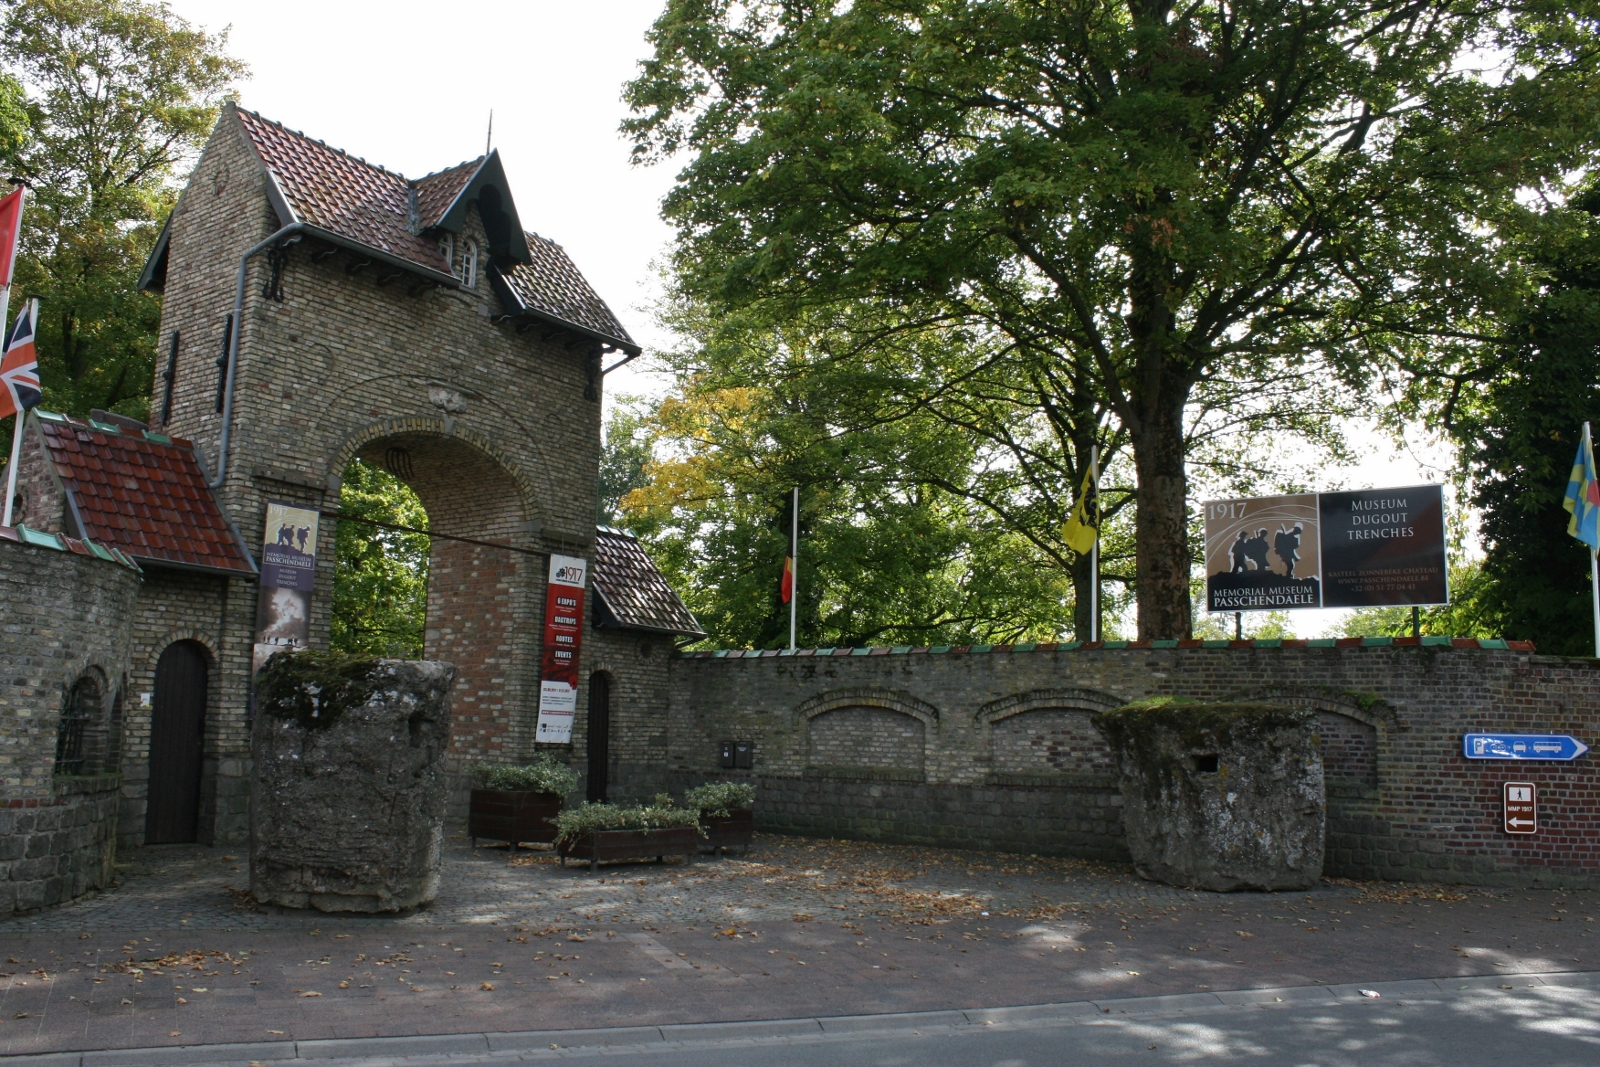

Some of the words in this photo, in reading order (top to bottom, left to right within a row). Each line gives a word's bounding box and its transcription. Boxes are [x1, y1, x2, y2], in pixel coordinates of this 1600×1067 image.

[1351, 498, 1408, 511] MUSEUM
[269, 505, 288, 516] 1917
[1207, 502, 1247, 520] 1917
[1352, 512, 1408, 526] DUGOUT
[1347, 527, 1414, 540] TRENCHES
[265, 556, 312, 567] PASSCHENDAELE
[565, 566, 583, 582] 1917
[1358, 569, 1402, 577] ZONNEBEKE
[1338, 575, 1429, 584] WWW.PASSCHENDAELE.BE
[1213, 587, 1267, 598] MEMORIAL
[1268, 585, 1313, 596] MUSEUM
[1364, 584, 1375, 592] (0)
[1214, 594, 1314, 607] PASSCHENDAELE
[555, 635, 574, 643] ROUTES
[555, 650, 572, 659] EVENTS
[1475, 741, 1482, 752] P
